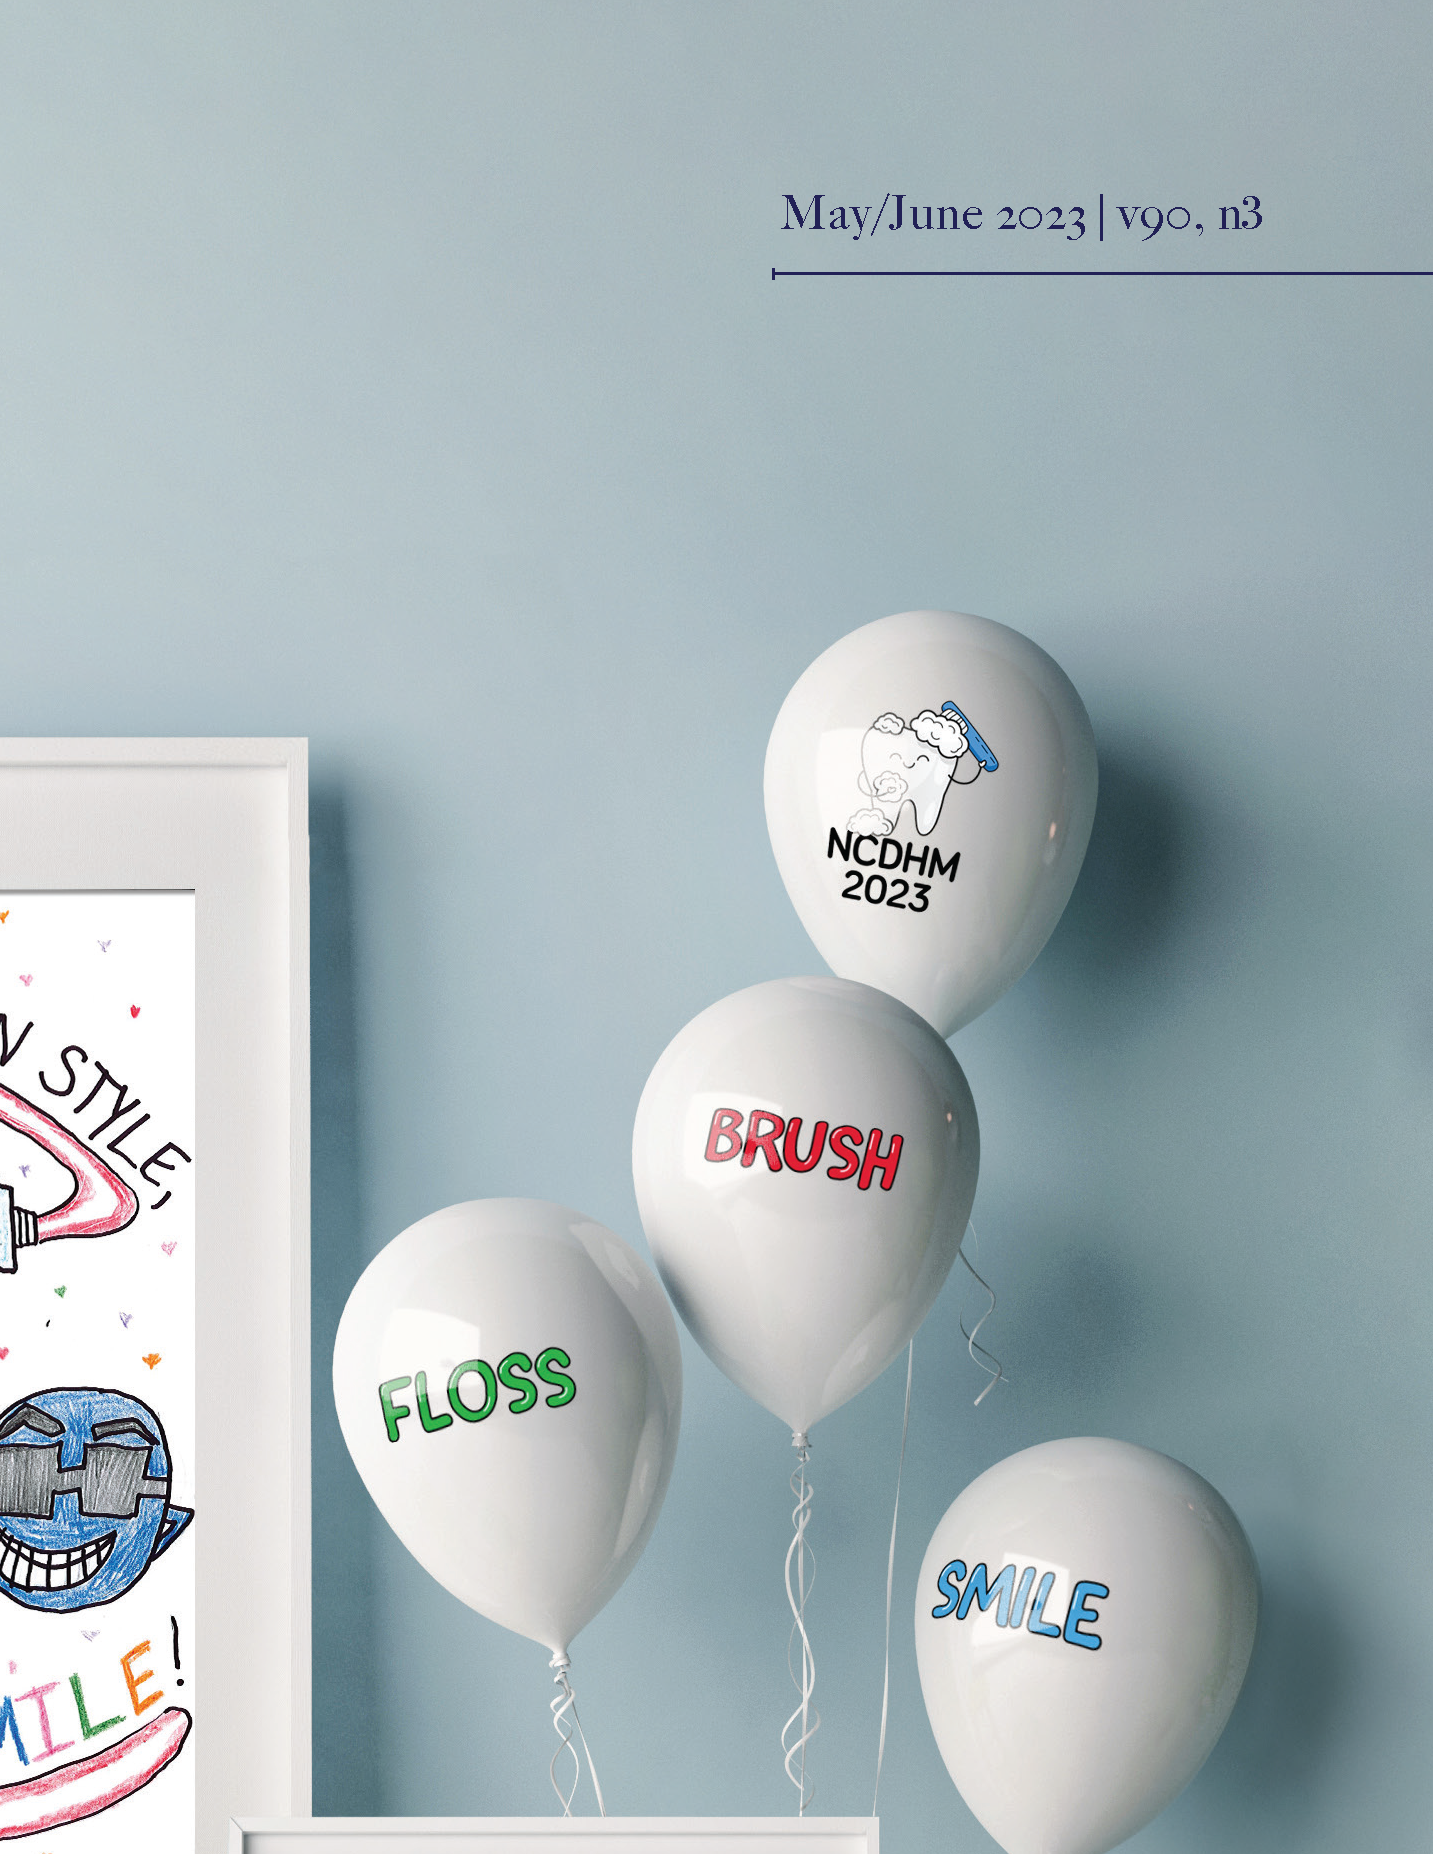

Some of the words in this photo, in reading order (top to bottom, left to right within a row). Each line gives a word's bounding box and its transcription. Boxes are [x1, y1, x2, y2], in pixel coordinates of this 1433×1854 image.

[827, 827, 961, 884] NCDHM
[841, 872, 931, 914] 2023
[40, 1044, 192, 1209] STYLE,
[707, 1110, 904, 1191] BRUSH
[379, 1347, 576, 1442] FLOSS
[932, 1560, 1109, 1650] SMILE
